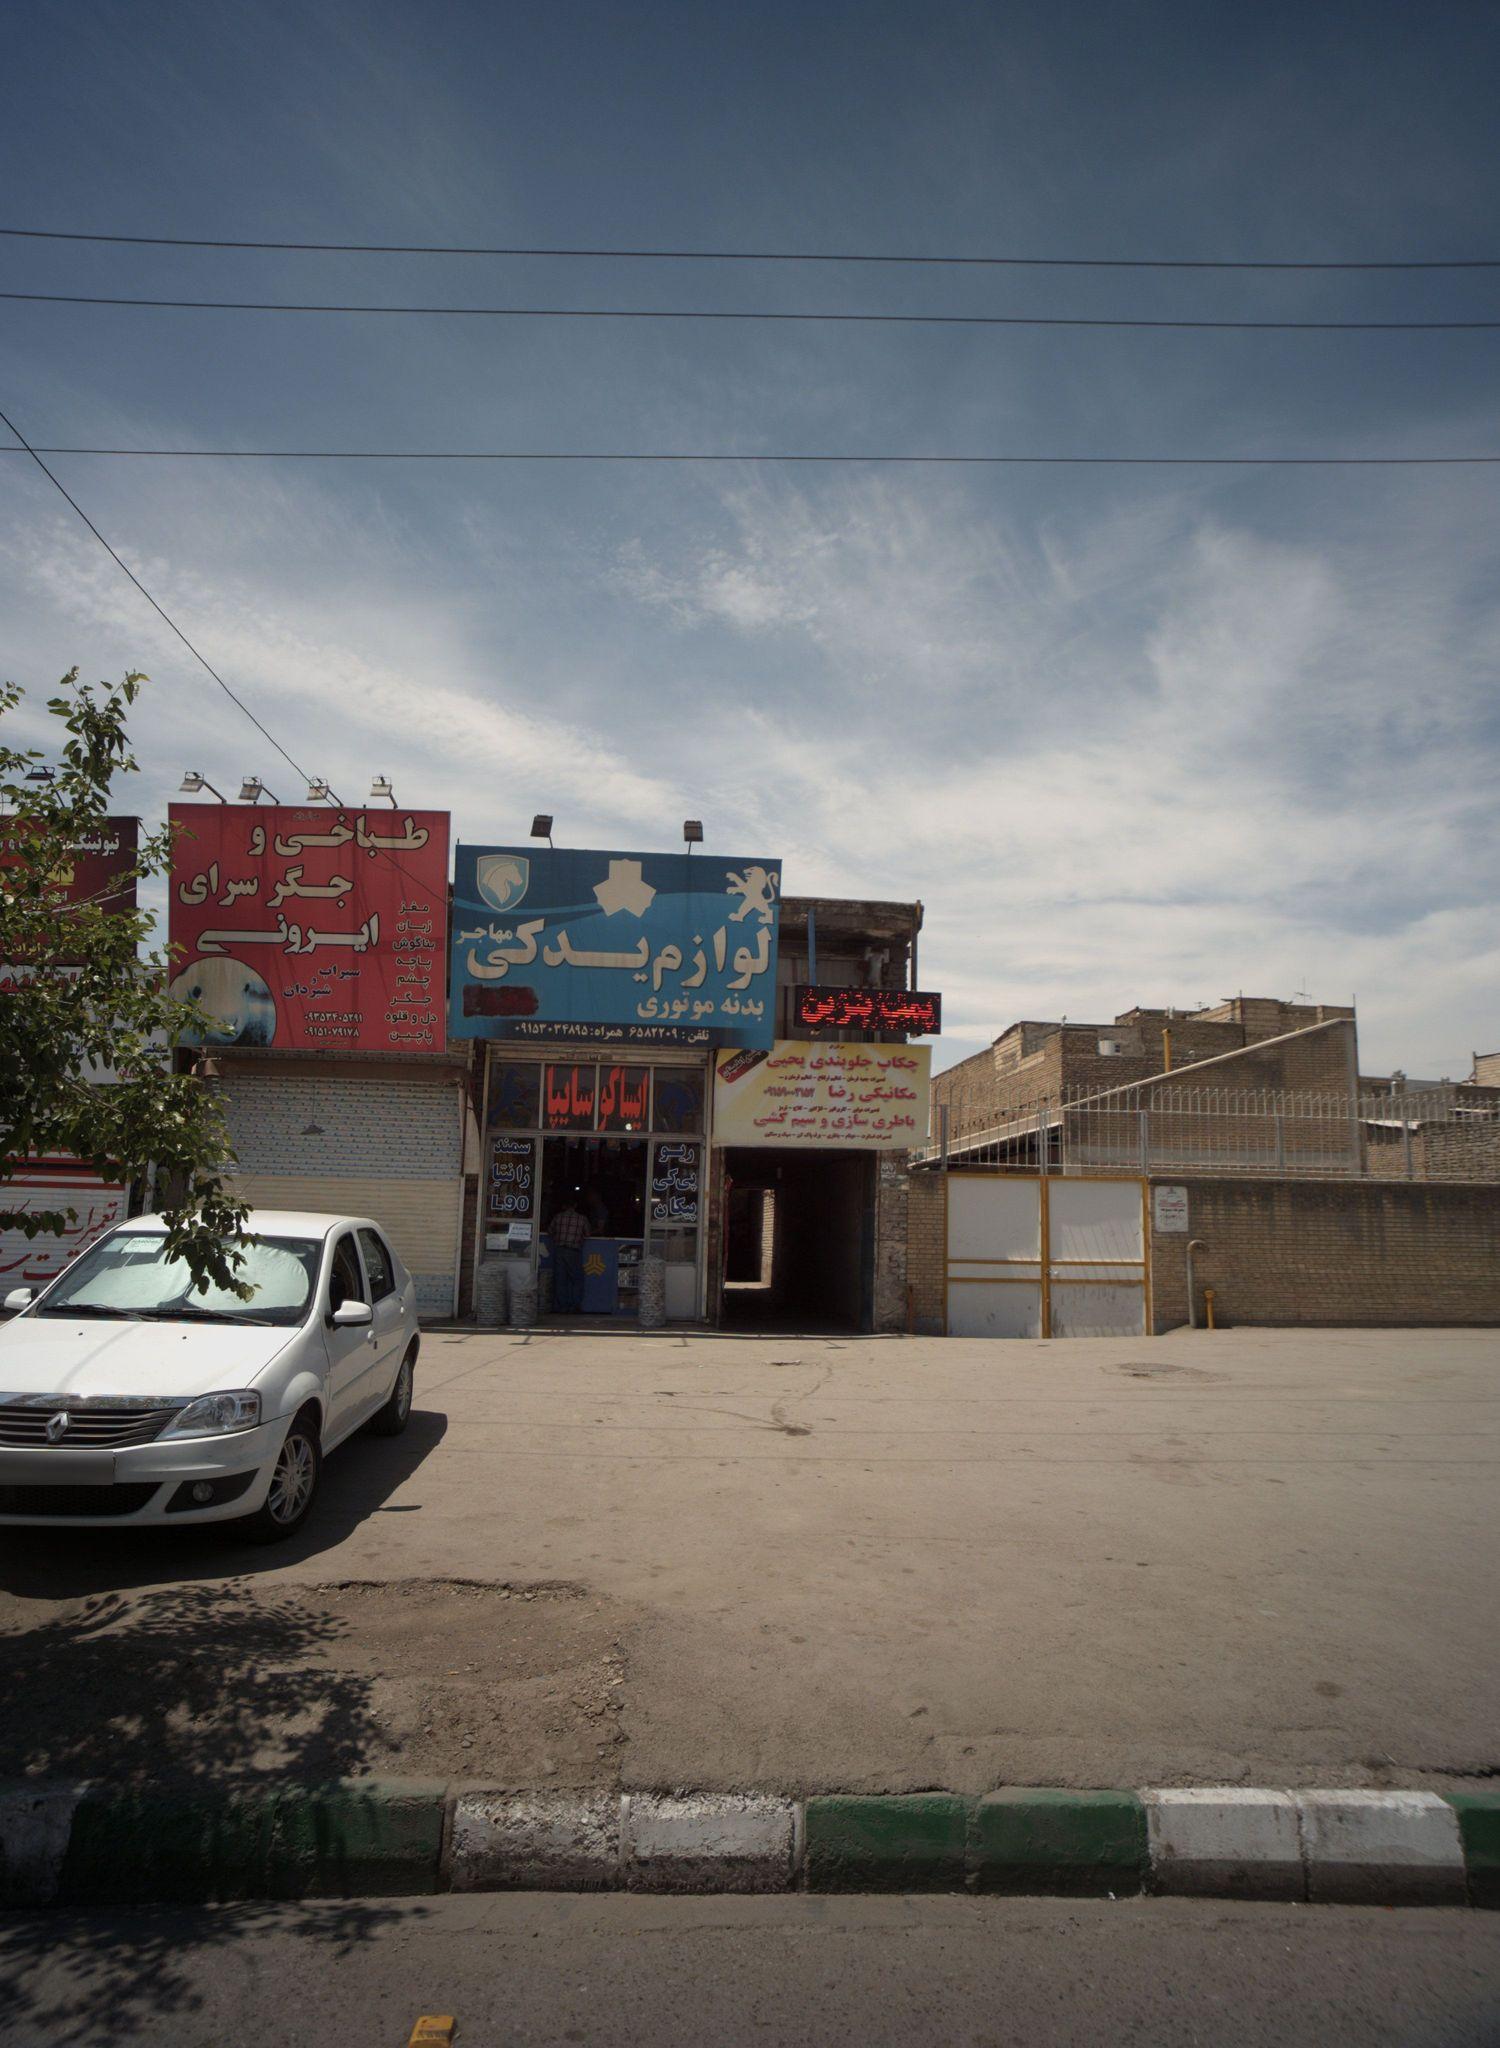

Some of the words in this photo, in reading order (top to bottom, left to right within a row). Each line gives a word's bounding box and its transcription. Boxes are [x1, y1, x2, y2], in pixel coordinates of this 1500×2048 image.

[247, 825, 267, 856] و
[274, 814, 430, 859] طباخی
[178, 860, 260, 907] سرای
[266, 864, 354, 909] جگر
[399, 900, 430, 914] مغز
[196, 911, 381, 954] ایرونی
[396, 919, 433, 933] زبان
[455, 923, 513, 944] مهاجر
[392, 936, 436, 951] بناگوش
[466, 918, 649, 983] یدکی
[396, 957, 432, 971] پاچه
[653, 925, 772, 991] لوازم
[397, 974, 431, 988] چشم
[283, 984, 331, 999] شیردان
[390, 992, 432, 1007] جگر
[637, 990, 715, 1020] موتوری
[720, 993, 765, 1021] بدنه
[384, 1010, 409, 1023] قلوه
[410, 1014, 418, 1024] و
[420, 1010, 437, 1025] دل
[389, 1028, 433, 1045] پاچین
[810, 1055, 873, 1071] جلوبندی
[546, 1065, 595, 1129] سایپا
[828, 1085, 855, 1102] رضا
[858, 1086, 917, 1102] مکانیکی
[753, 1112, 788, 1127] کشی
[791, 1115, 816, 1128] سیم
[820, 1116, 828, 1129] و
[831, 1113, 868, 1130] سازی
[872, 1113, 915, 1131] باطری
[494, 1137, 531, 1154] سمند
[658, 1143, 695, 1163] ریو
[492, 1162, 530, 1189] زانتیا
[491, 1194, 530, 1212] L90
[653, 1196, 697, 1221] پیکان
